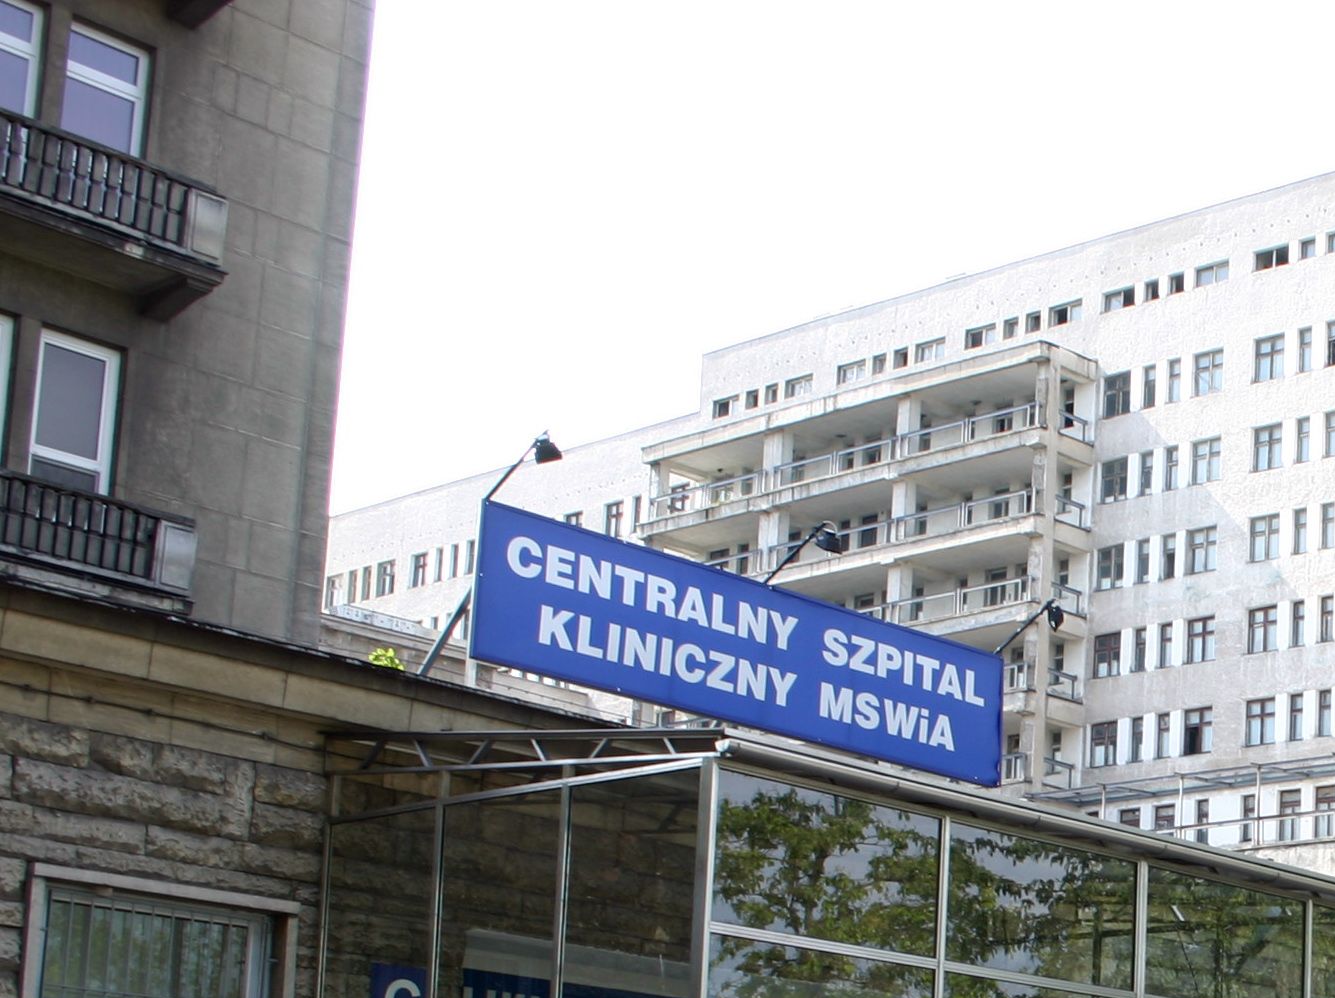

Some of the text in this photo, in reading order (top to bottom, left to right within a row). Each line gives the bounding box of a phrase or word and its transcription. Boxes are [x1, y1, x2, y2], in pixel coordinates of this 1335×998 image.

[506, 536, 986, 707] CENTRALNY SZPITAL
[537, 604, 956, 752] KLINICZNY MSWiA
